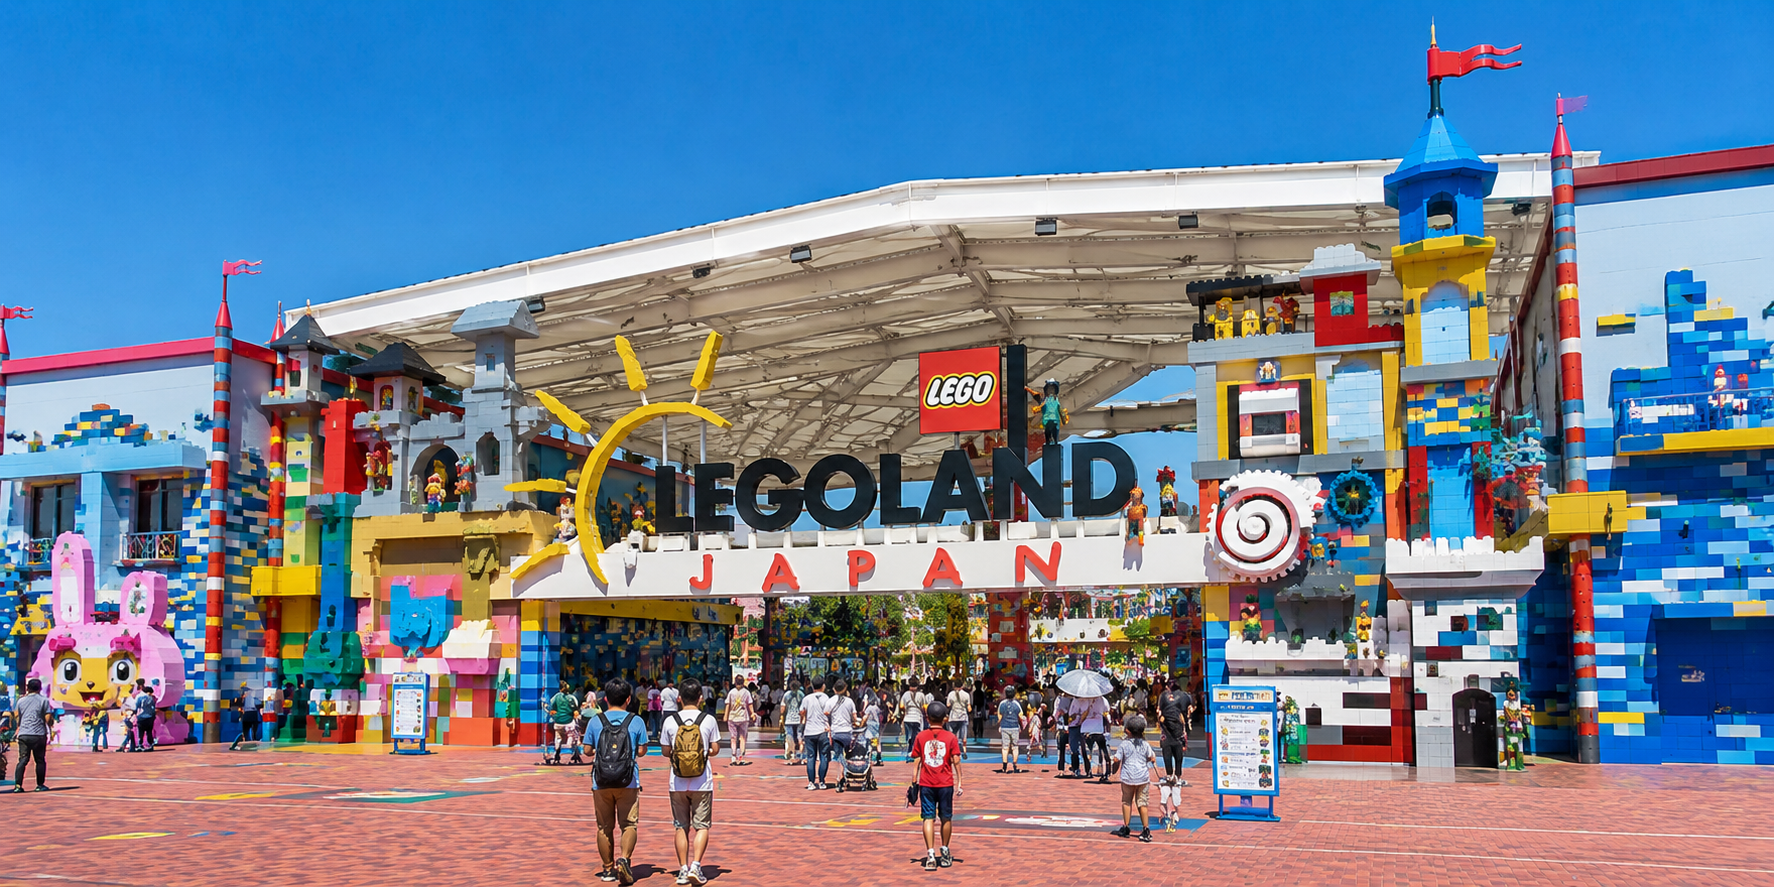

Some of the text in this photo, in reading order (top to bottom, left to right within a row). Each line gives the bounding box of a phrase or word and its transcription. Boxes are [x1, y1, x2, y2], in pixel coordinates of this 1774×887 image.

[925, 374, 994, 407] LEGO
[655, 441, 1137, 533] LEGOLAND
[689, 541, 1062, 593] JAPAN
